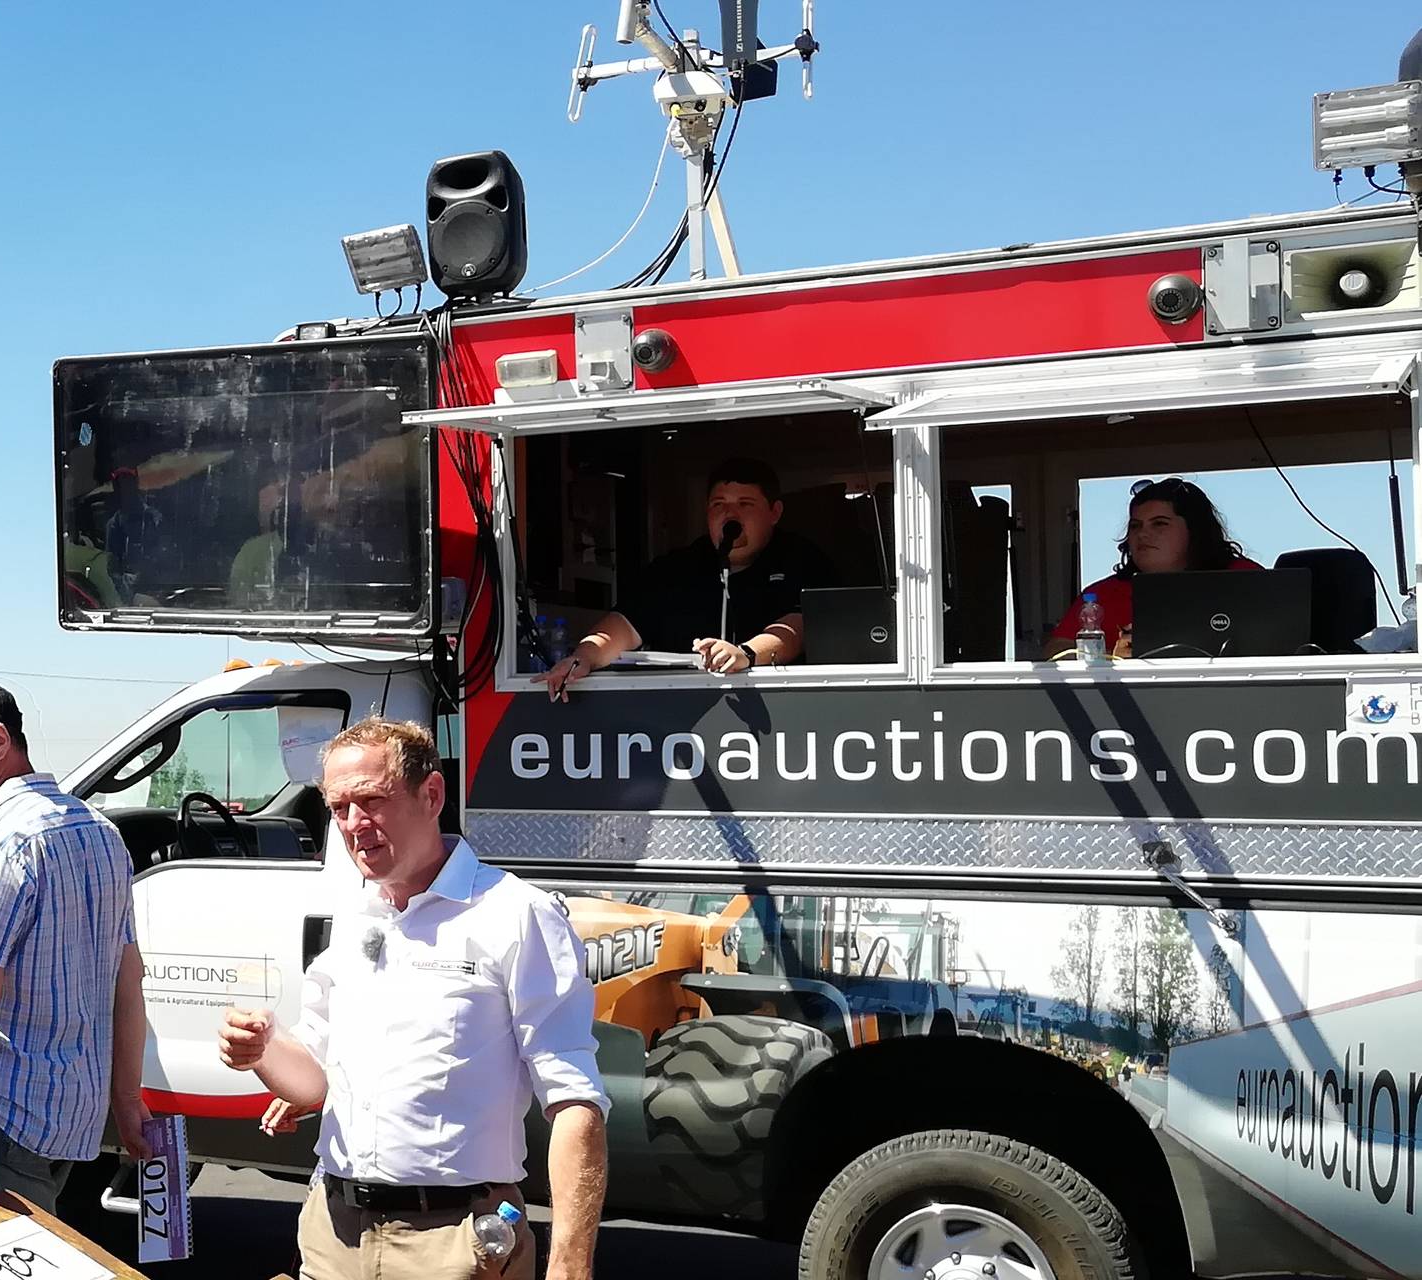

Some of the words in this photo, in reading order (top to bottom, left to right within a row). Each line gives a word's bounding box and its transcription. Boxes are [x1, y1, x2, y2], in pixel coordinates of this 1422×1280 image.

[510, 710, 1420, 785] euroauctions.com
[584, 920, 666, 985] 1121F
[143, 1159, 169, 1240] 0127
